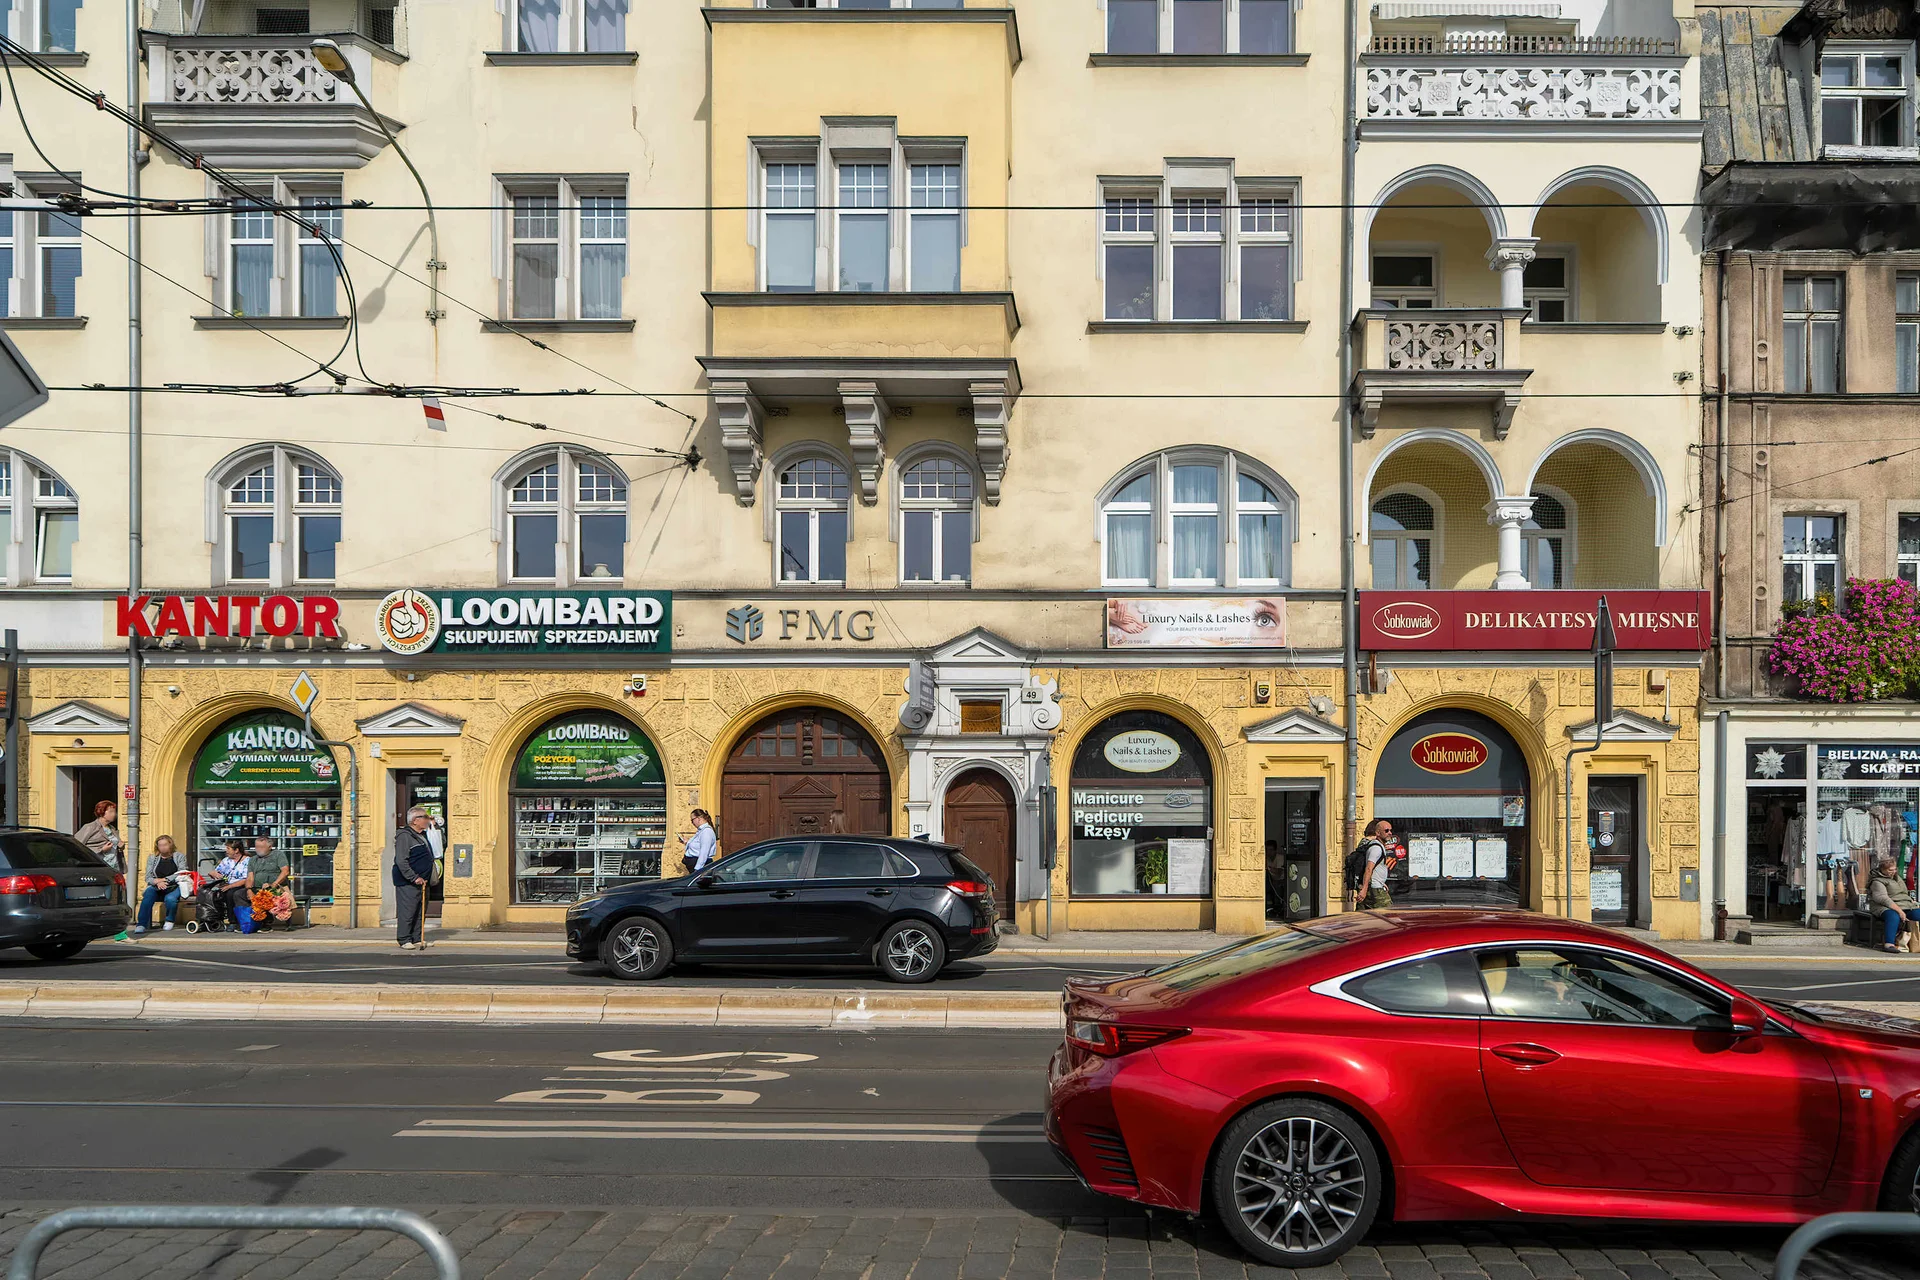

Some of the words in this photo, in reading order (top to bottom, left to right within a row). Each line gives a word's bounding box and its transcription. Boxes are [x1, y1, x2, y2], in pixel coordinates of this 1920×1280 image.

[116, 595, 342, 637] KANTOR
[441, 597, 664, 626] LOOMBARD
[1383, 608, 1433, 629] Sobkowiak
[779, 609, 876, 641] FMG
[1142, 614, 1176, 626] Luxury
[1179, 613, 1203, 623] Nails
[1205, 614, 1214, 623] &
[1216, 613, 1251, 623] Lashes
[1465, 612, 1599, 628] DELIKATESY
[1617, 612, 1699, 633] MIĘSNE
[444, 630, 539, 644] SKUPUJEMY
[544, 629, 660, 644] SPRZEDAJEMY
[1026, 691, 1037, 699] 49
[227, 725, 316, 750] KANTOR
[547, 723, 630, 741] LOOMBARD
[1128, 736, 1157, 745] Luxury
[229, 754, 278, 762] WYMIANY
[279, 754, 314, 762] WALUT
[534, 754, 576, 763] POŻYCZKI
[1112, 746, 1133, 756] Nails
[1134, 747, 1142, 756] &
[1143, 747, 1172, 756] Lashes
[1422, 740, 1480, 763] Sobkowiak
[1828, 750, 1889, 760] BIELIZNA
[1900, 750, 1920, 760] RA
[1074, 792, 1144, 804] Manicure
[1074, 810, 1144, 823] Pedicure
[1084, 824, 1131, 840] Rzęsy
[495, 1048, 819, 1105] BUS
